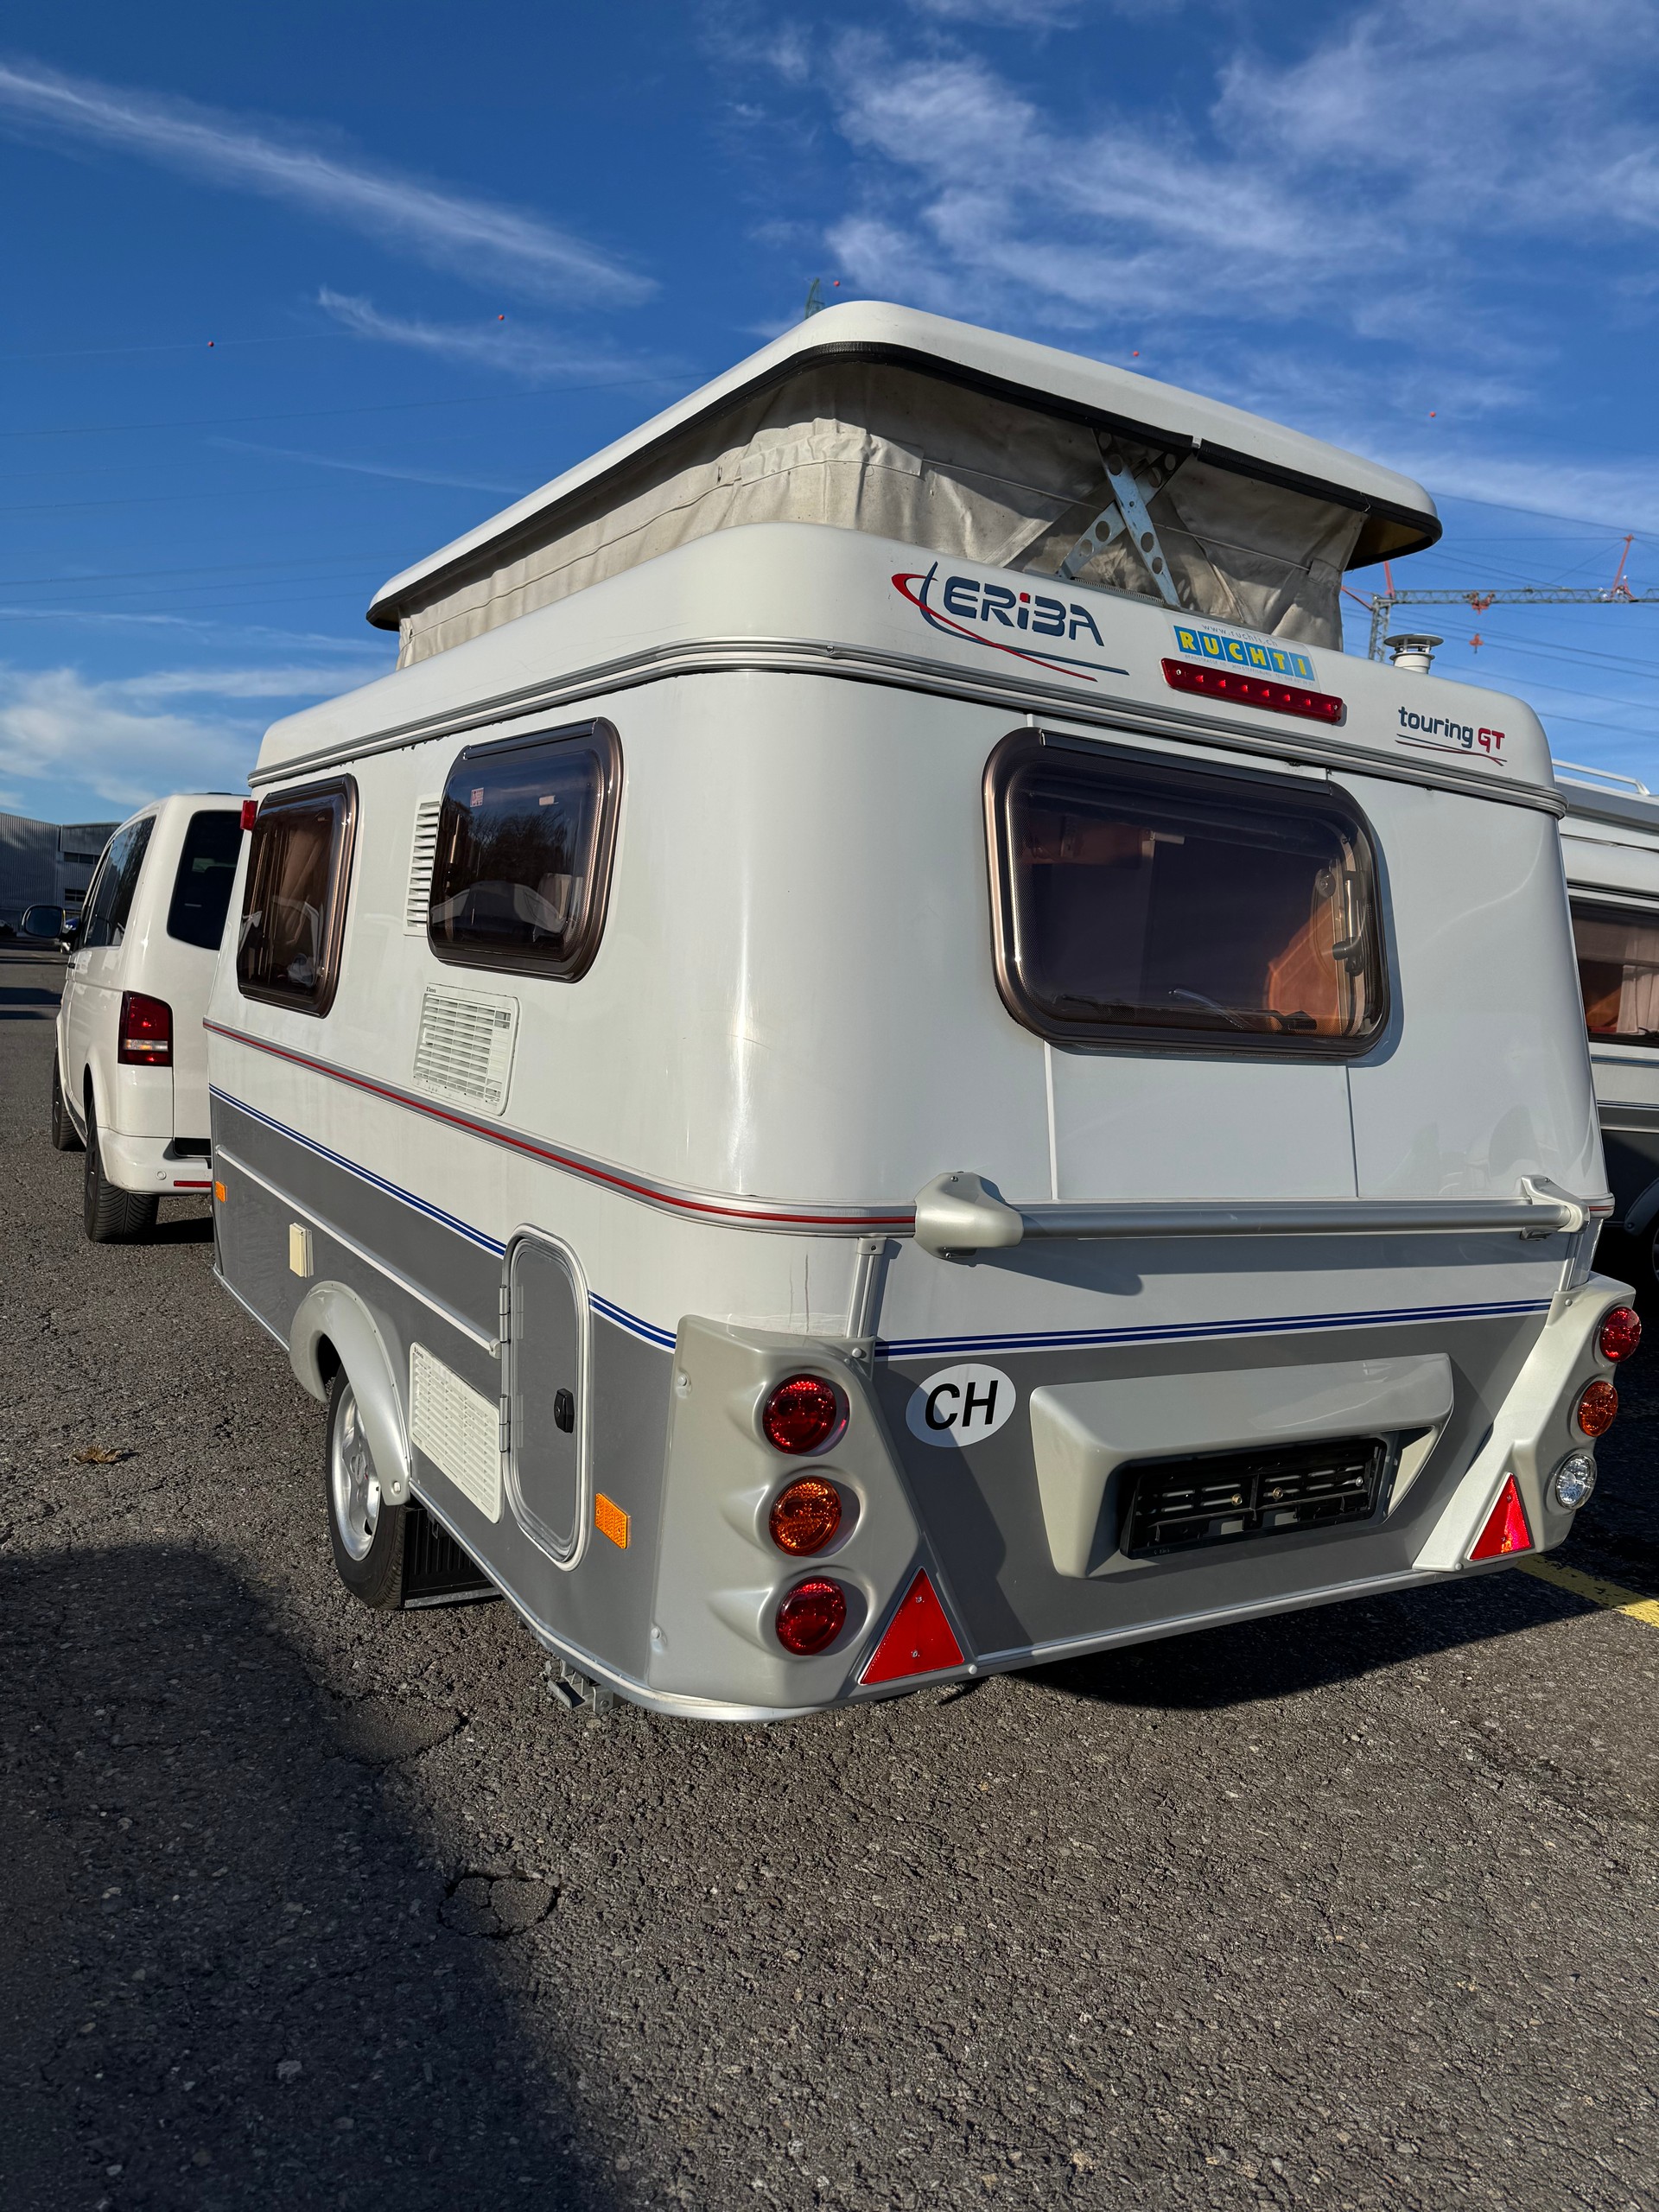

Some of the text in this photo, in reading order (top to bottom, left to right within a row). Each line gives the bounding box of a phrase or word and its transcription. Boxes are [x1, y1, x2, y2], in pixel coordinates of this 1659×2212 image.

[1179, 630, 1307, 676] RUCHTI
[1202, 624, 1279, 647] www.ruchti.ch
[1398, 706, 1505, 753] touring GT
[925, 1380, 999, 1431] CH
